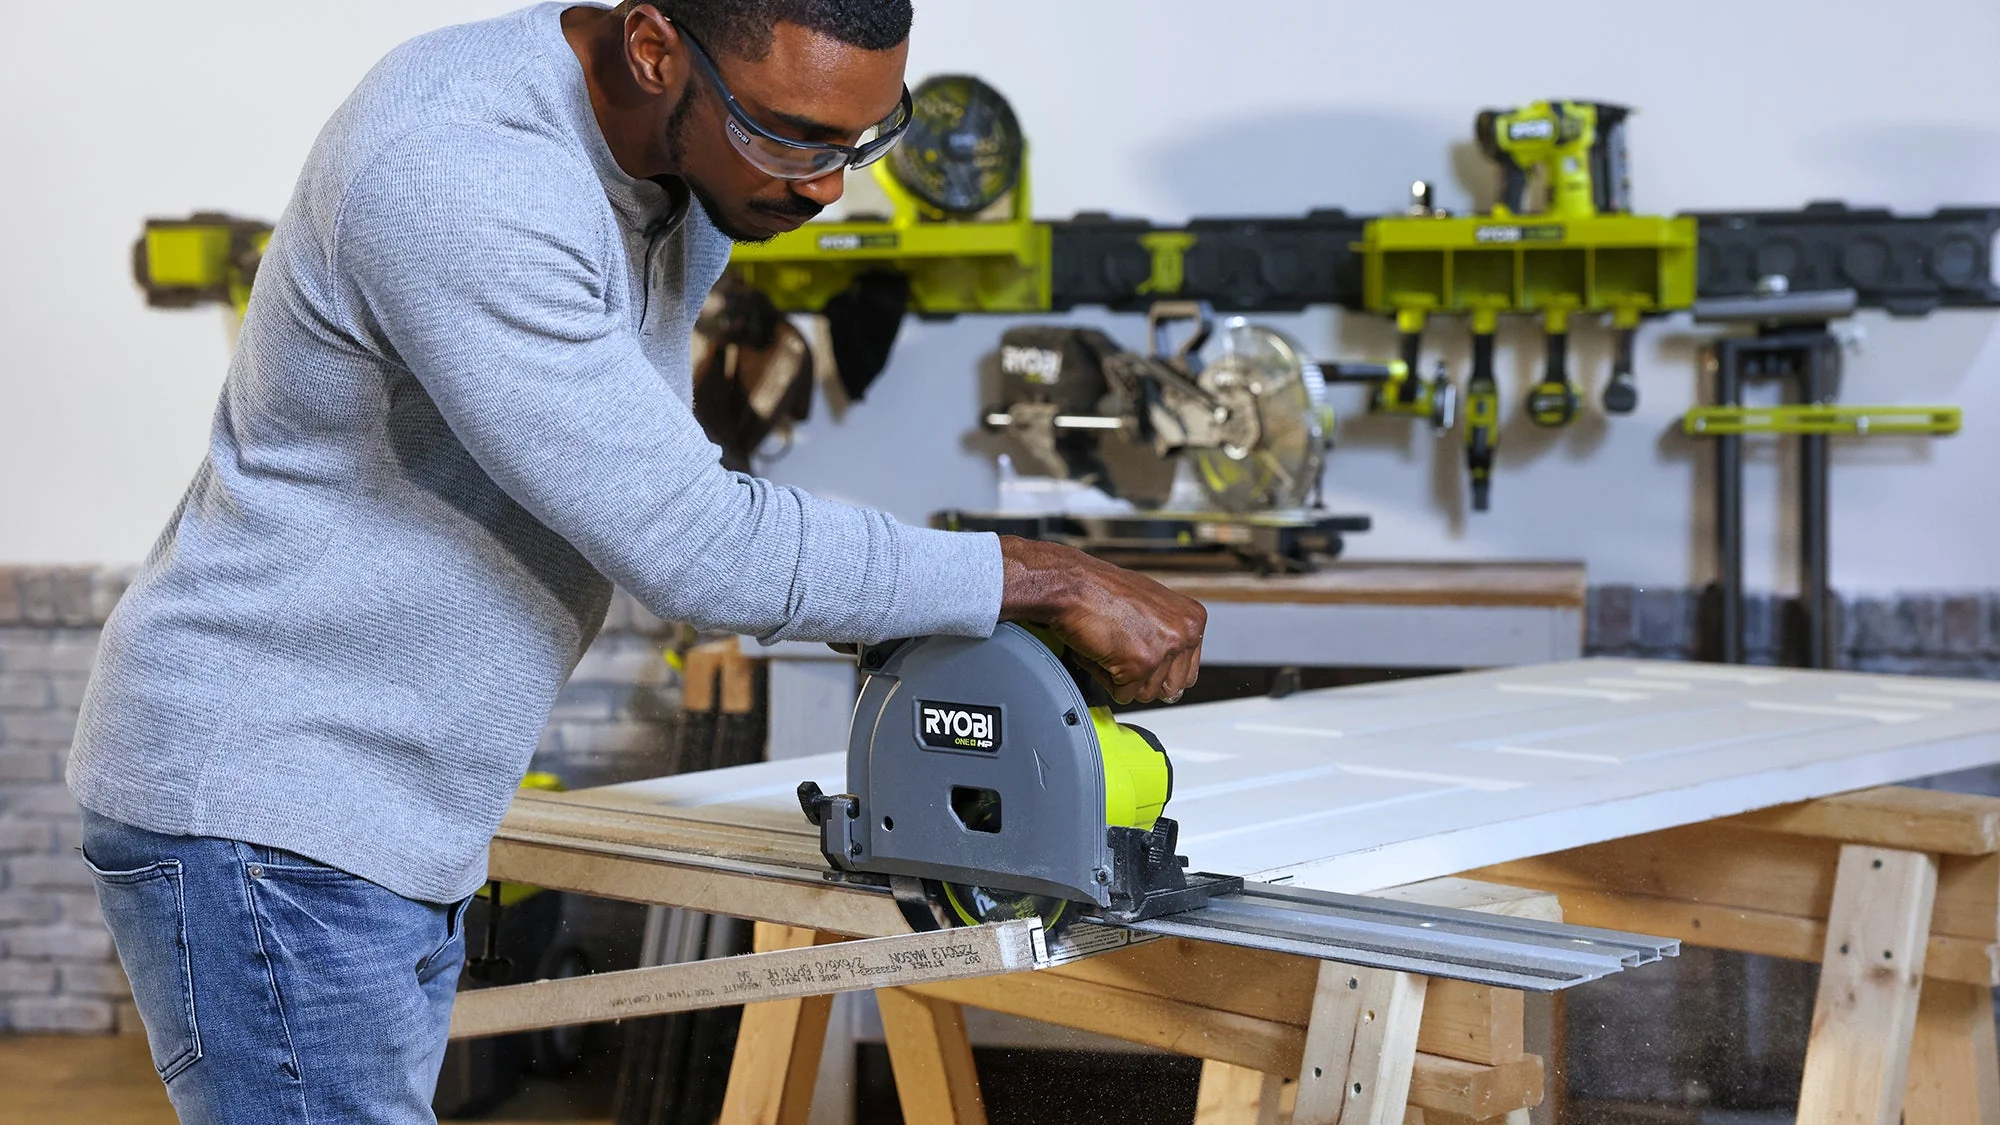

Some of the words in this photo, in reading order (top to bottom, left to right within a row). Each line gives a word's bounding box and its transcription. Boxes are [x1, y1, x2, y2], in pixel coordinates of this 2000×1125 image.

[730, 122, 750, 144] RYOBI
[924, 707, 993, 740] RYOBI
[976, 739, 993, 748] HP
[888, 948, 928, 965] MASON
